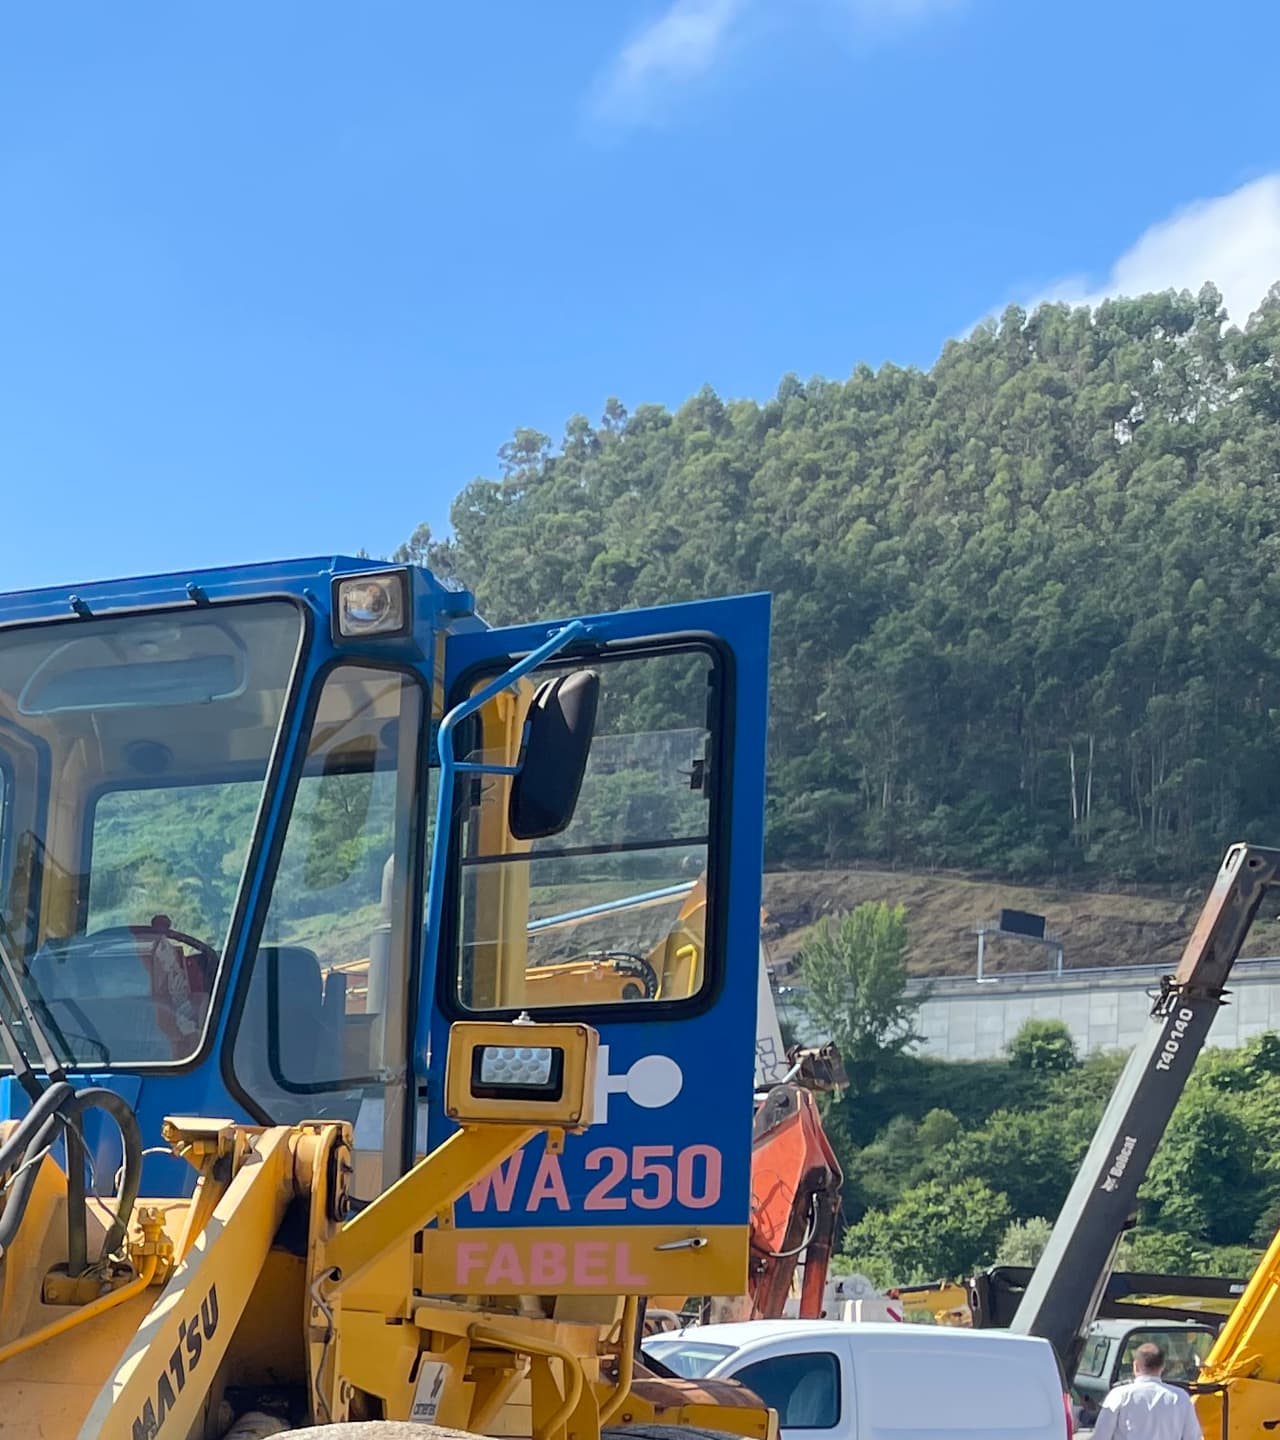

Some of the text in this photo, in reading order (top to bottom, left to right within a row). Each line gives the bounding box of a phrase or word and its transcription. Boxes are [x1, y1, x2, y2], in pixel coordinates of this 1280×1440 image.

[1156, 1007, 1193, 1071] T40140
[468, 1144, 723, 1213] WA 250
[1109, 1135, 1137, 1178] Bobcat
[455, 1240, 649, 1287] FABEL
